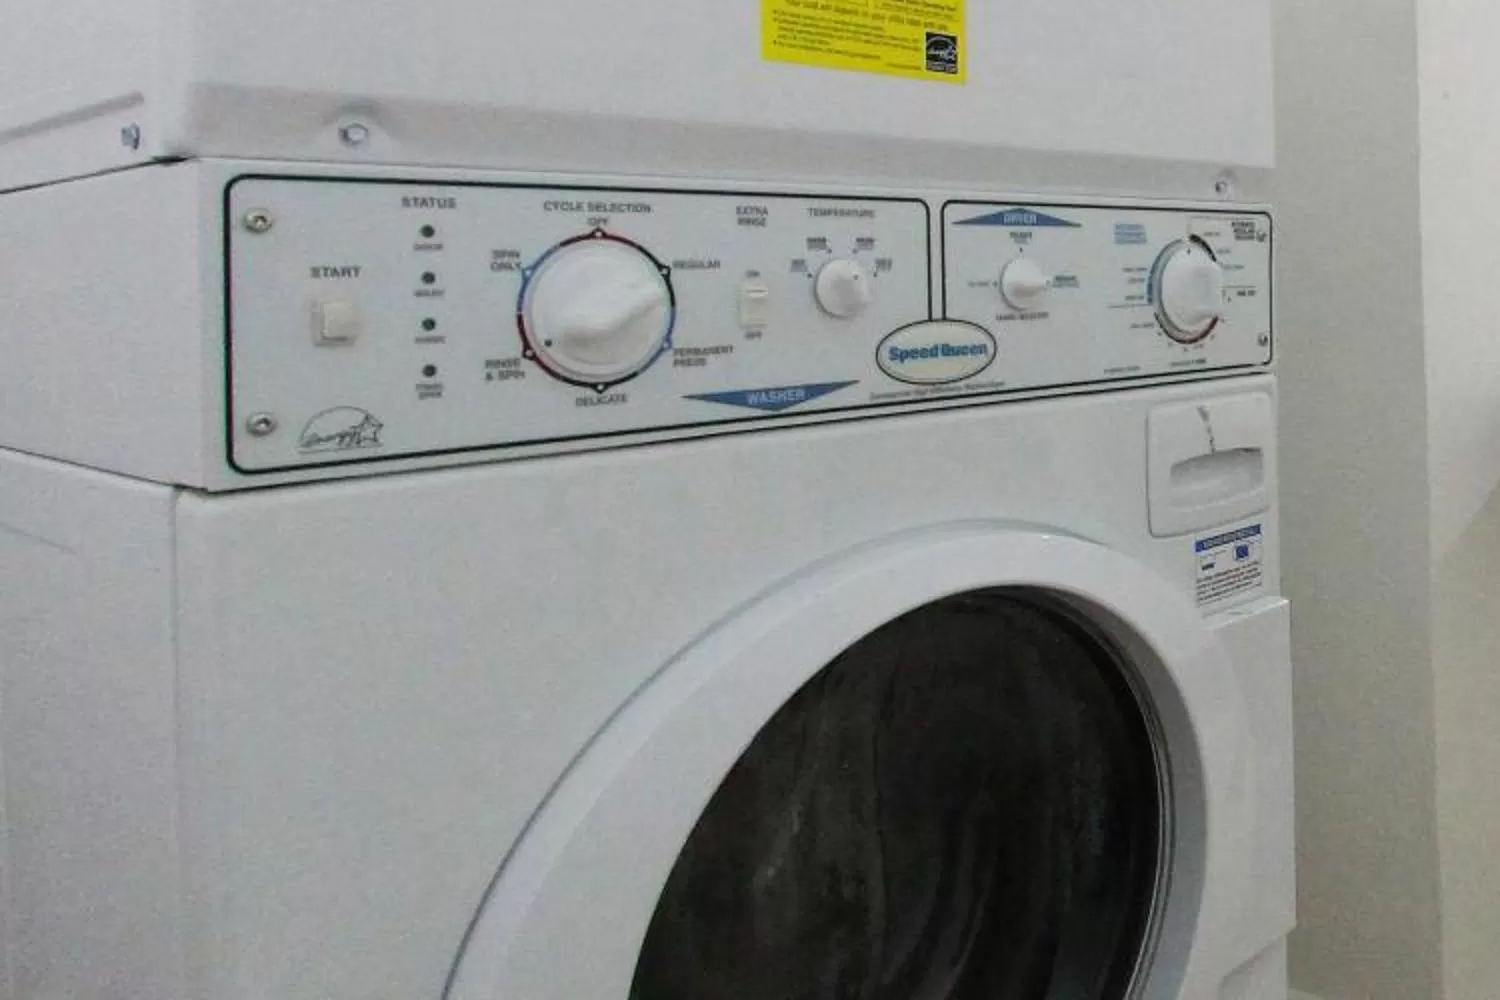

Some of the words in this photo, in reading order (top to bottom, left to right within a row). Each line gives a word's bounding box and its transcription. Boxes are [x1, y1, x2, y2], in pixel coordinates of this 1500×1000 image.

[402, 196, 456, 209] STATUS
[543, 201, 584, 213] CYCLE
[587, 201, 652, 214] SELECTION
[310, 266, 361, 279] START
[888, 344, 939, 364] Speed
[941, 343, 988, 357] Queen
[747, 389, 806, 406] WASHER
